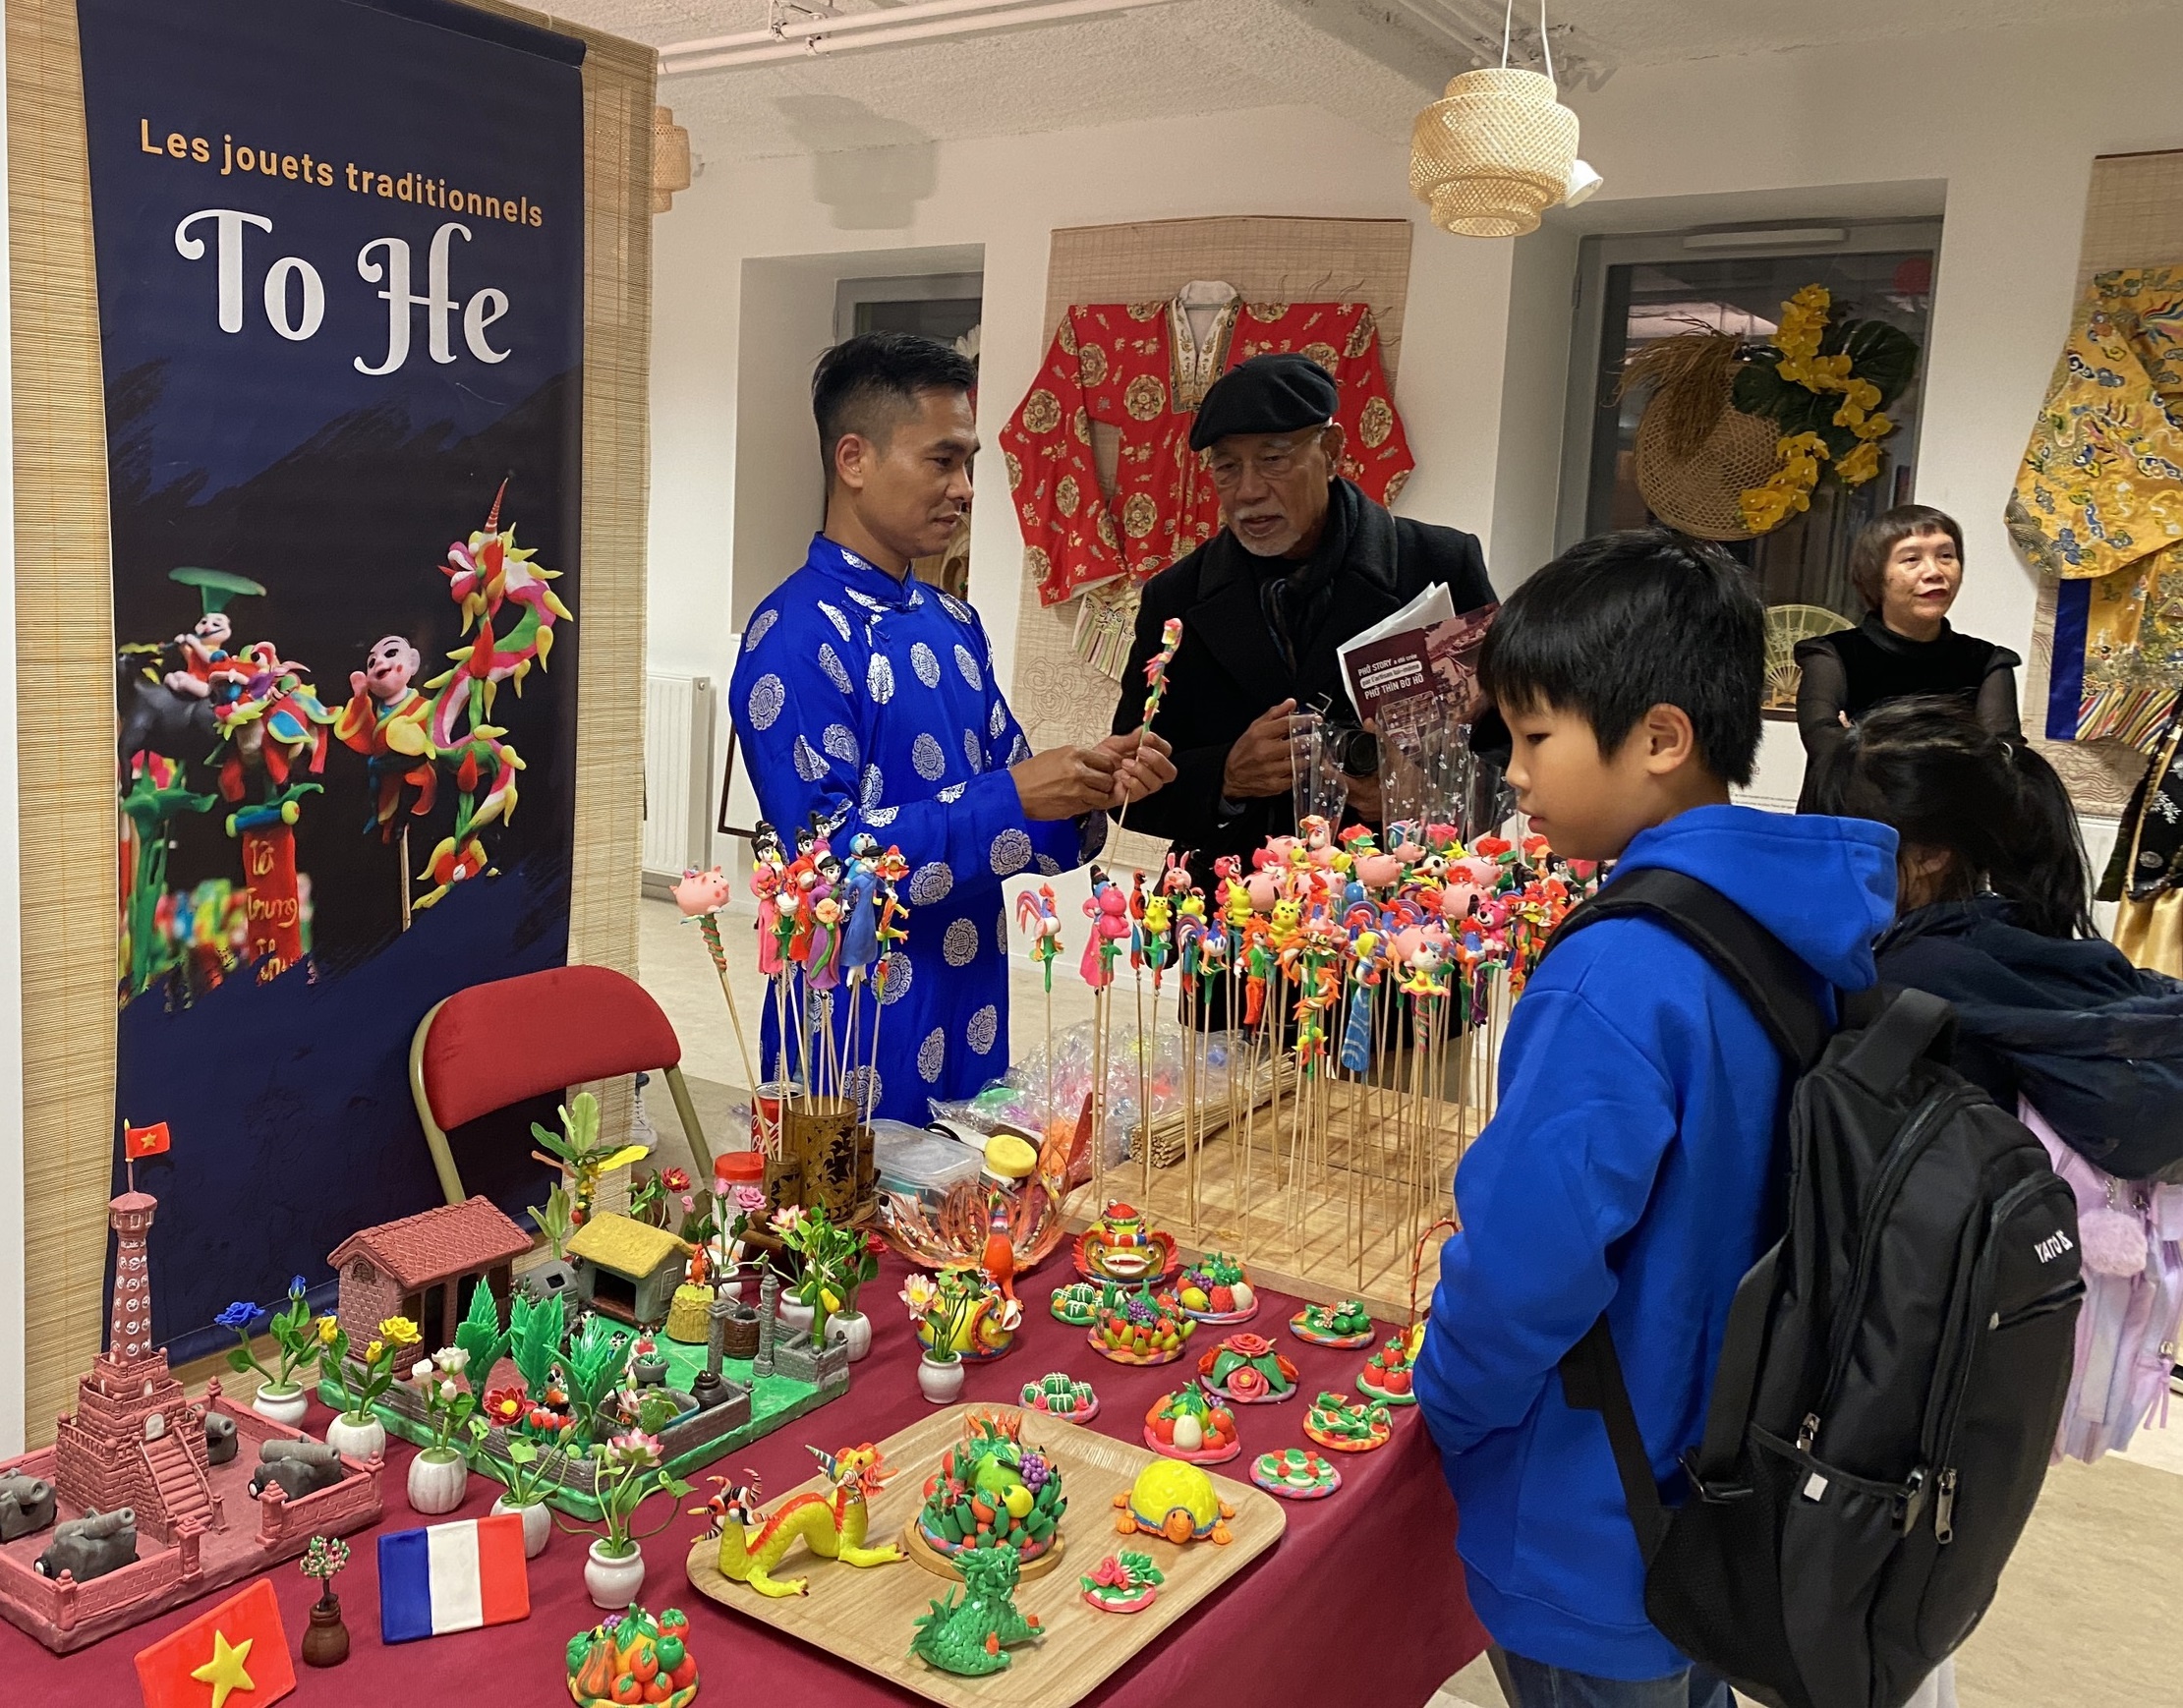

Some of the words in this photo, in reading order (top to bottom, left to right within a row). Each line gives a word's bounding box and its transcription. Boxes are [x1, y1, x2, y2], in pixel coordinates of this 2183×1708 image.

[140, 118, 210, 163] Les
[220, 135, 334, 188] jouets
[346, 162, 543, 227] traditionnels
[174, 208, 325, 341] To
[353, 222, 511, 375] He
[1372, 658, 1392, 671] STORY
